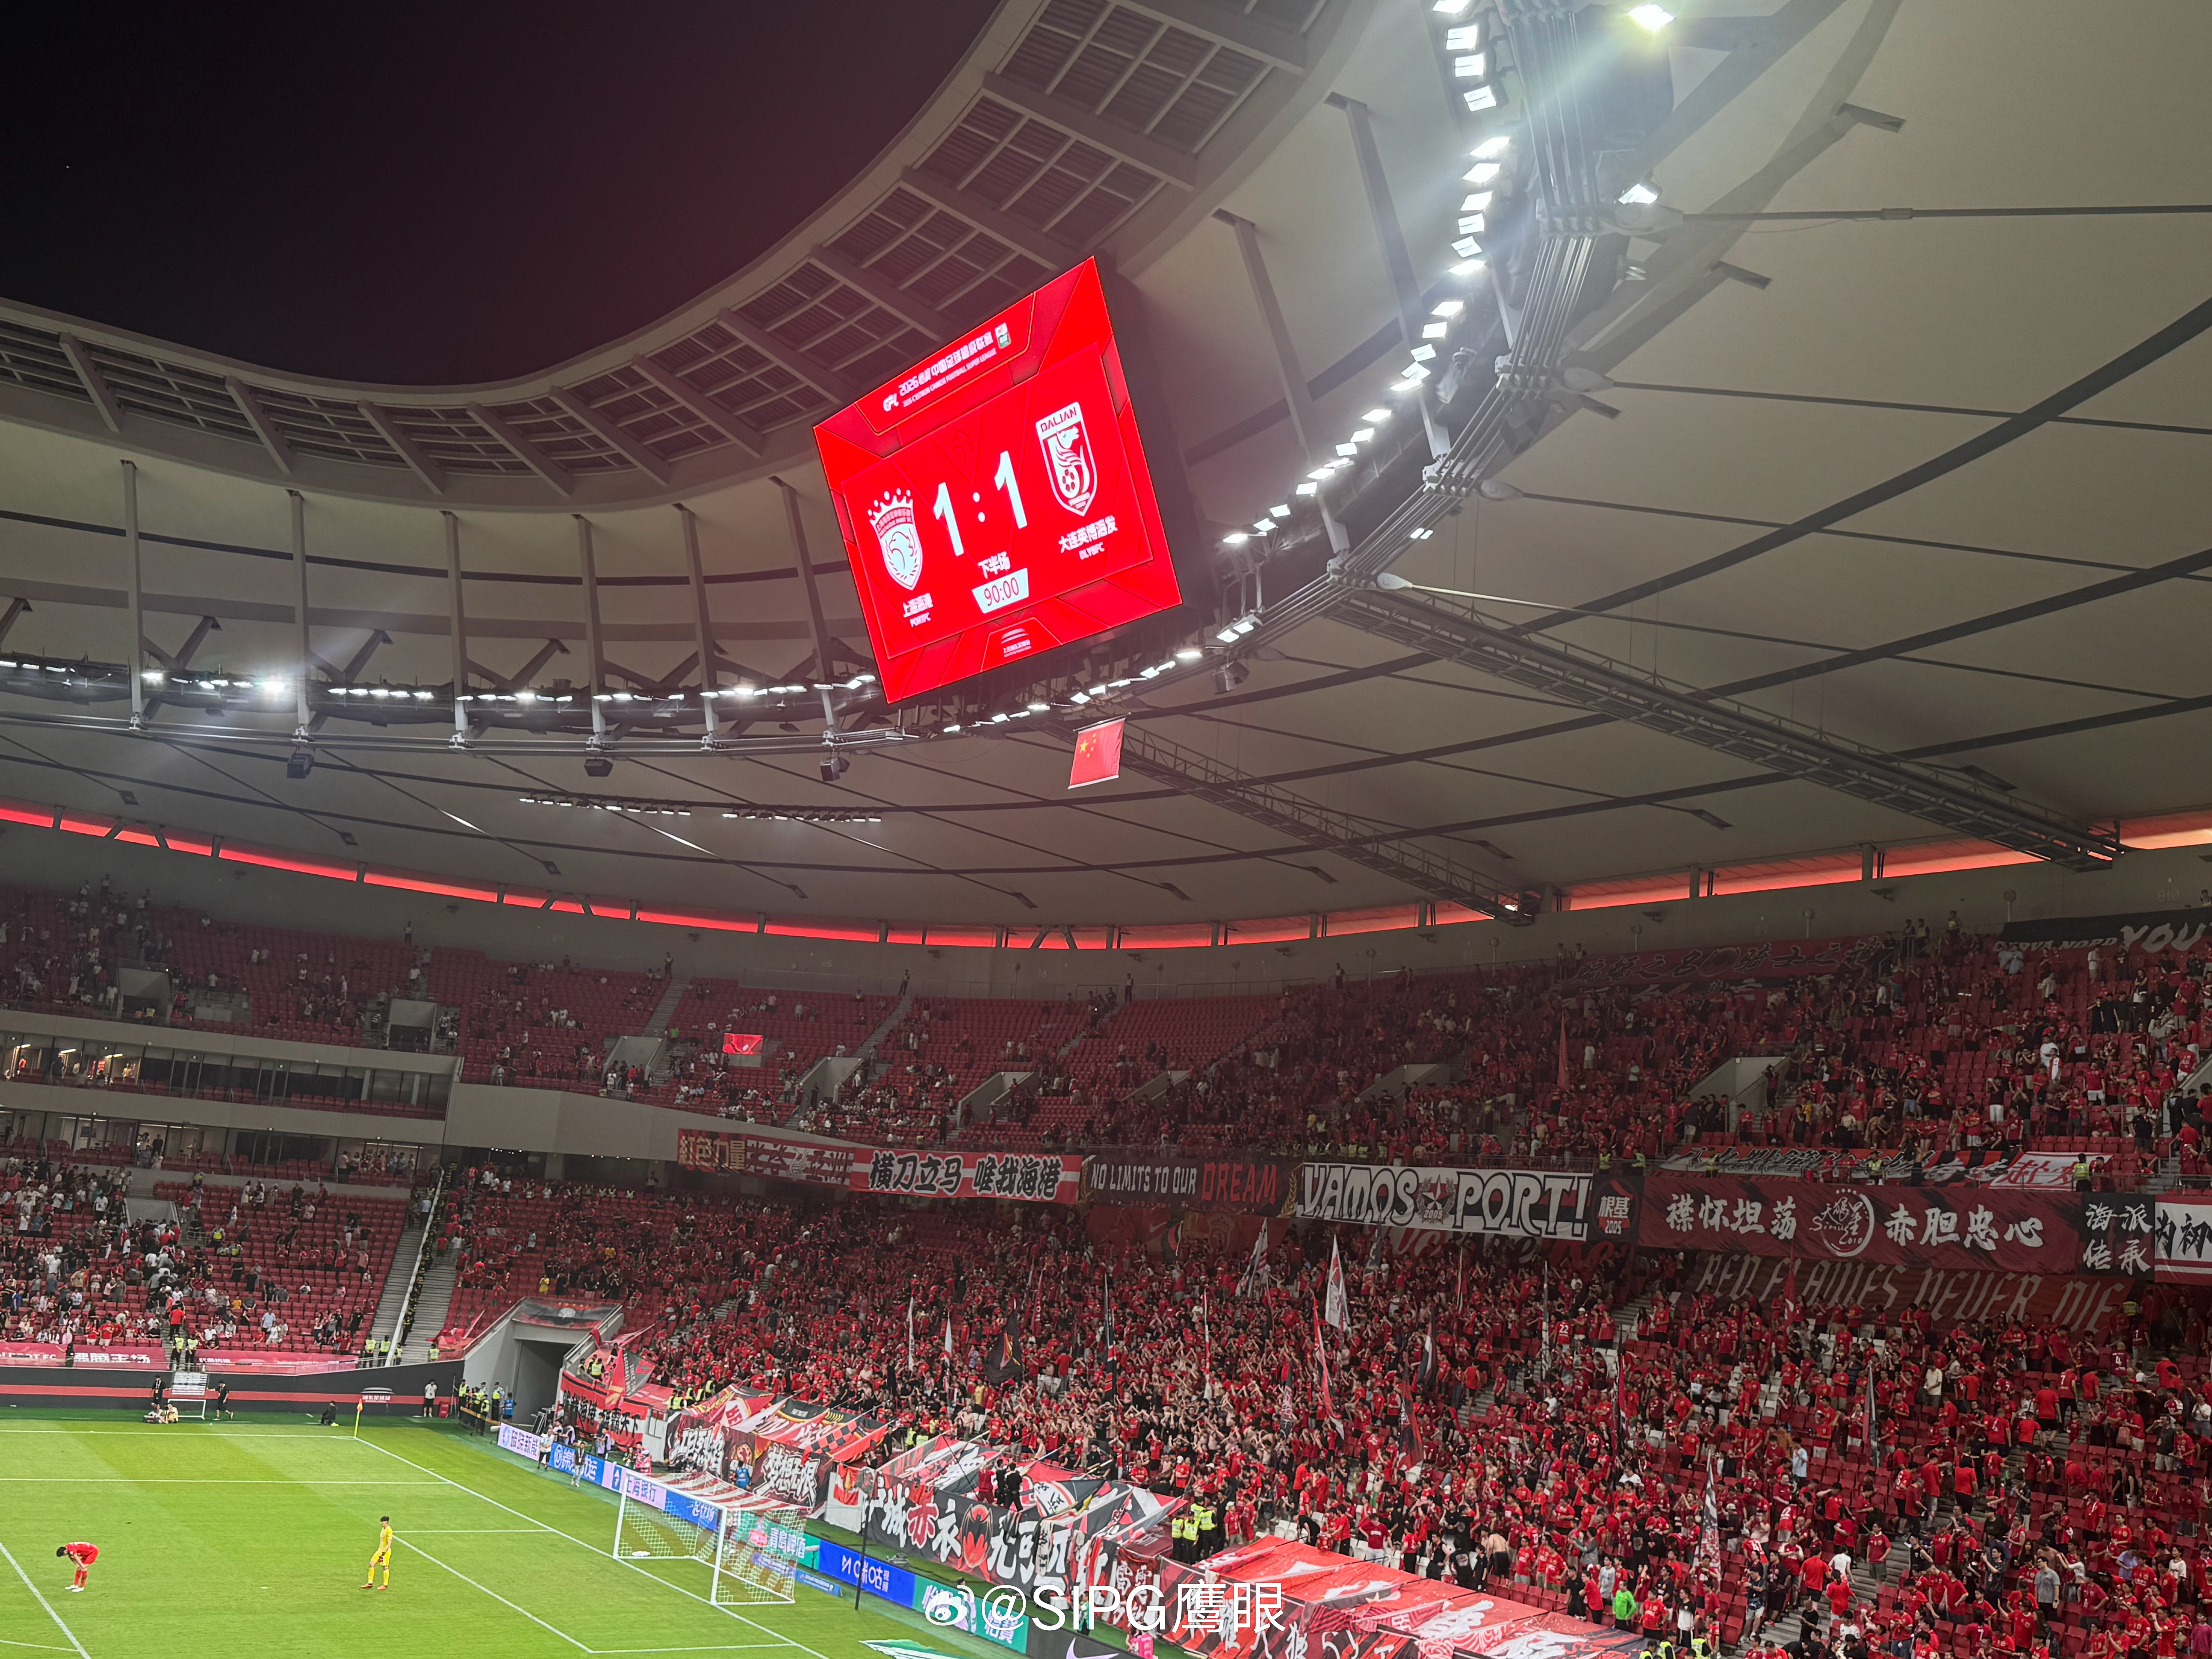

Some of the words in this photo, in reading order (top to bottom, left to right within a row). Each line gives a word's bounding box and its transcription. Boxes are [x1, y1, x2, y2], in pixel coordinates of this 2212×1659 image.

[1040, 407, 1077, 432] DALIAN
[933, 482, 964, 556] 1
[994, 450, 1027, 529] 1
[1058, 515, 1118, 553] 大连英博海发
[978, 551, 1011, 579] 下半场
[984, 577, 1019, 606] 90:00
[2059, 937, 2118, 949] NORD
[2119, 922, 2212, 953] YOU
[679, 1135, 746, 1173] 紅色力量
[869, 1151, 963, 1195] 横刀立马
[973, 1154, 1063, 1200] 唯我海港
[1091, 1163, 1106, 1190] NO
[1109, 1164, 1150, 1192] LIMITS
[1154, 1166, 1169, 1194] TO
[1172, 1167, 1197, 1195] OUR
[1202, 1162, 1277, 1205] DREAM
[1300, 1164, 1420, 1226] VAMOS
[1455, 1171, 1593, 1237] PORT!
[1423, 1209, 1443, 1220] 2005
[1599, 1196, 1631, 1219] 根基
[1605, 1220, 1622, 1235] 2005
[1666, 1193, 1798, 1240] 襟怀坦荡
[1885, 1203, 2044, 1251] 赤胆忠心
[2085, 1203, 2153, 1234] 海派
[2083, 1239, 2152, 1274] 传承
[1697, 1254, 1765, 1303] RED
[1914, 1267, 2045, 1321] NEVER
[2051, 1281, 2133, 1333] DIE
[1559, 1324, 1569, 1334] 22
[2115, 1356, 2122, 1365] 4
[2061, 1375, 2066, 1384] 7
[627, 1477, 657, 1502] 上海银行
[1978, 1629, 1984, 1642] 7
